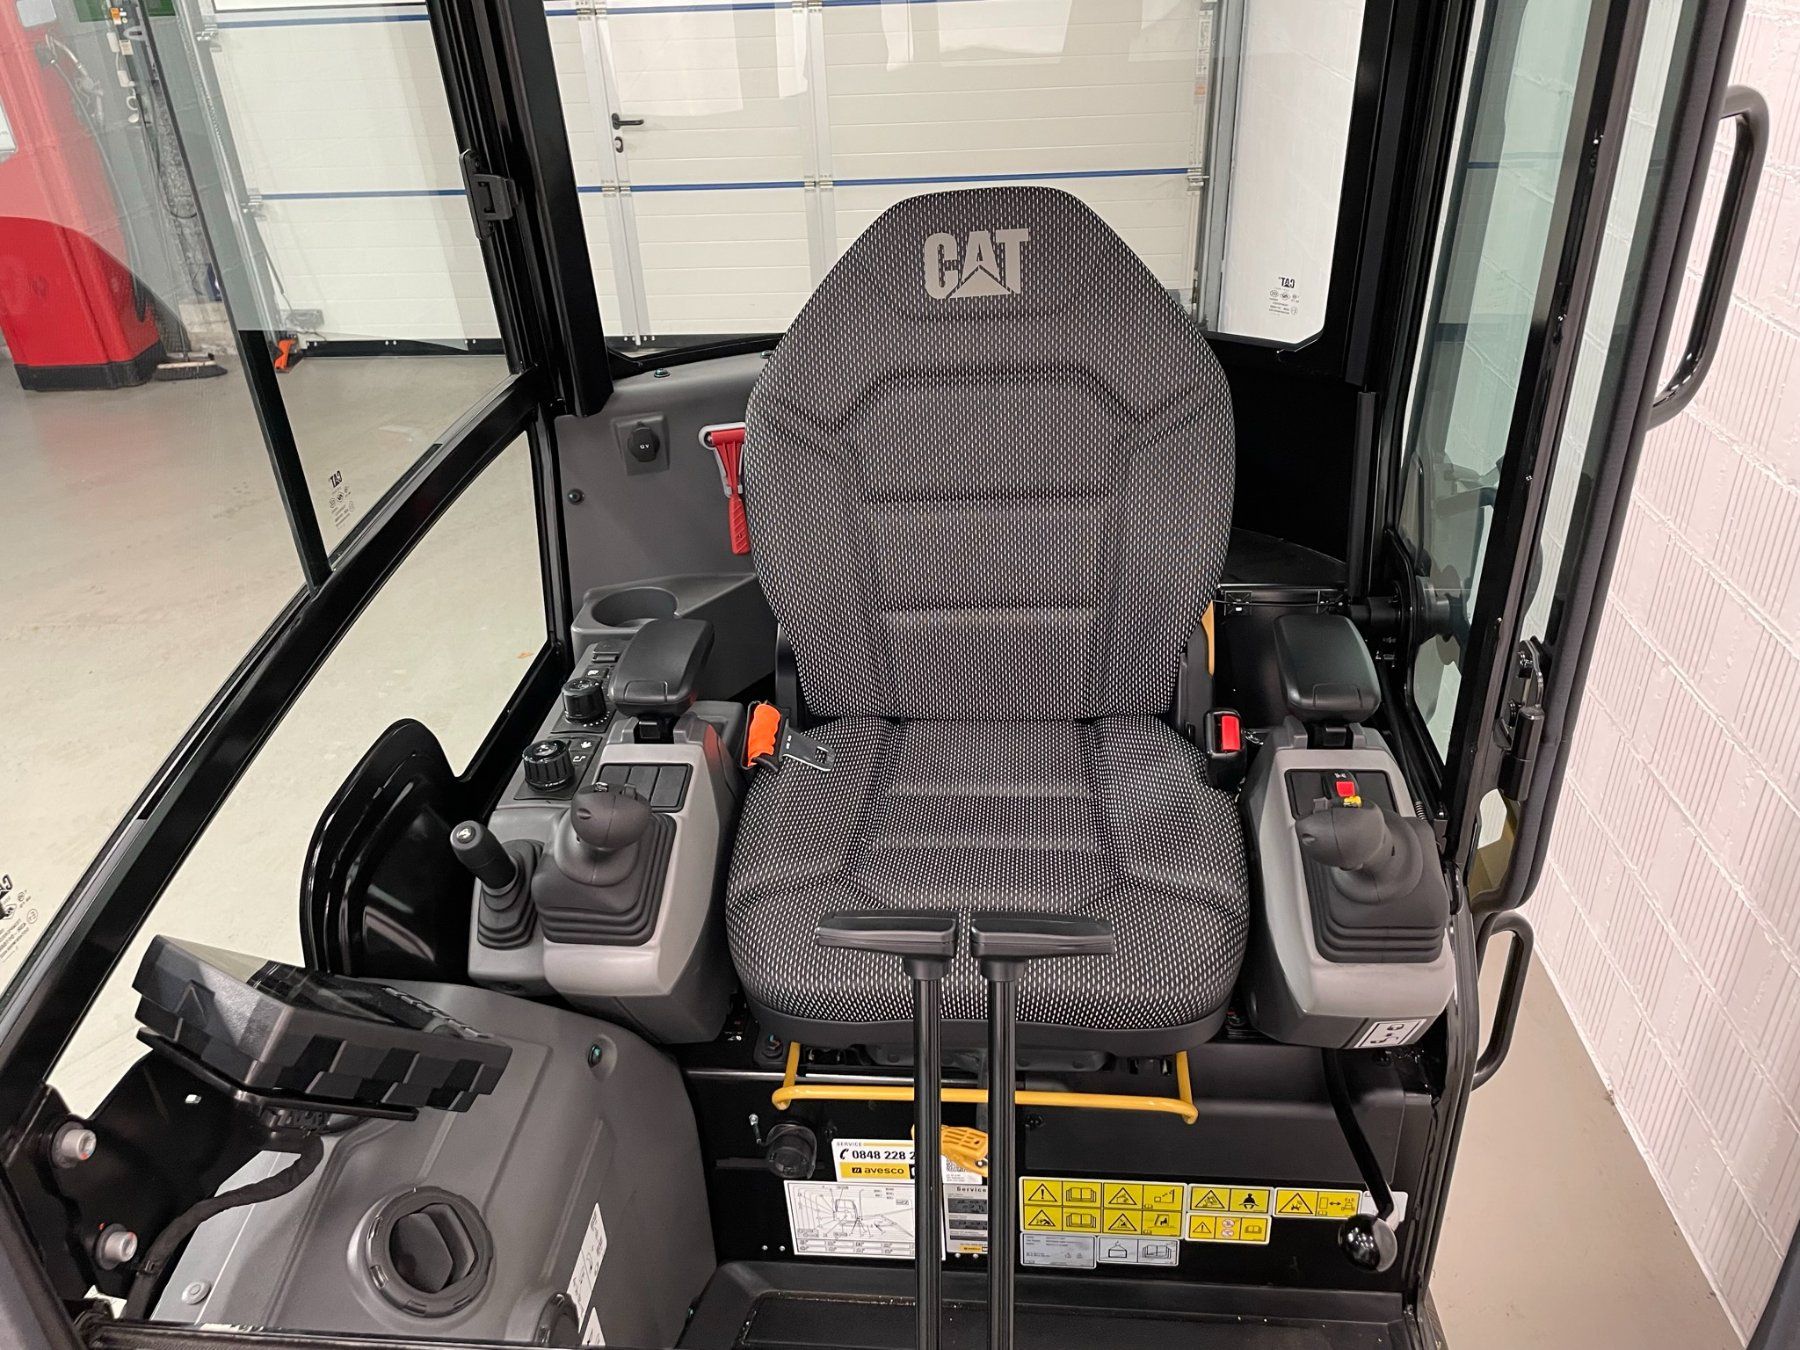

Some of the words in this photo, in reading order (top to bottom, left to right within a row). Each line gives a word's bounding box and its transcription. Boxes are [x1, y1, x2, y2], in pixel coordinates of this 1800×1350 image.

[924, 228, 1029, 300] CAT
[852, 1150, 881, 1160] 0848
[884, 1151, 906, 1160] 228
[864, 1167, 905, 1175] avesco
